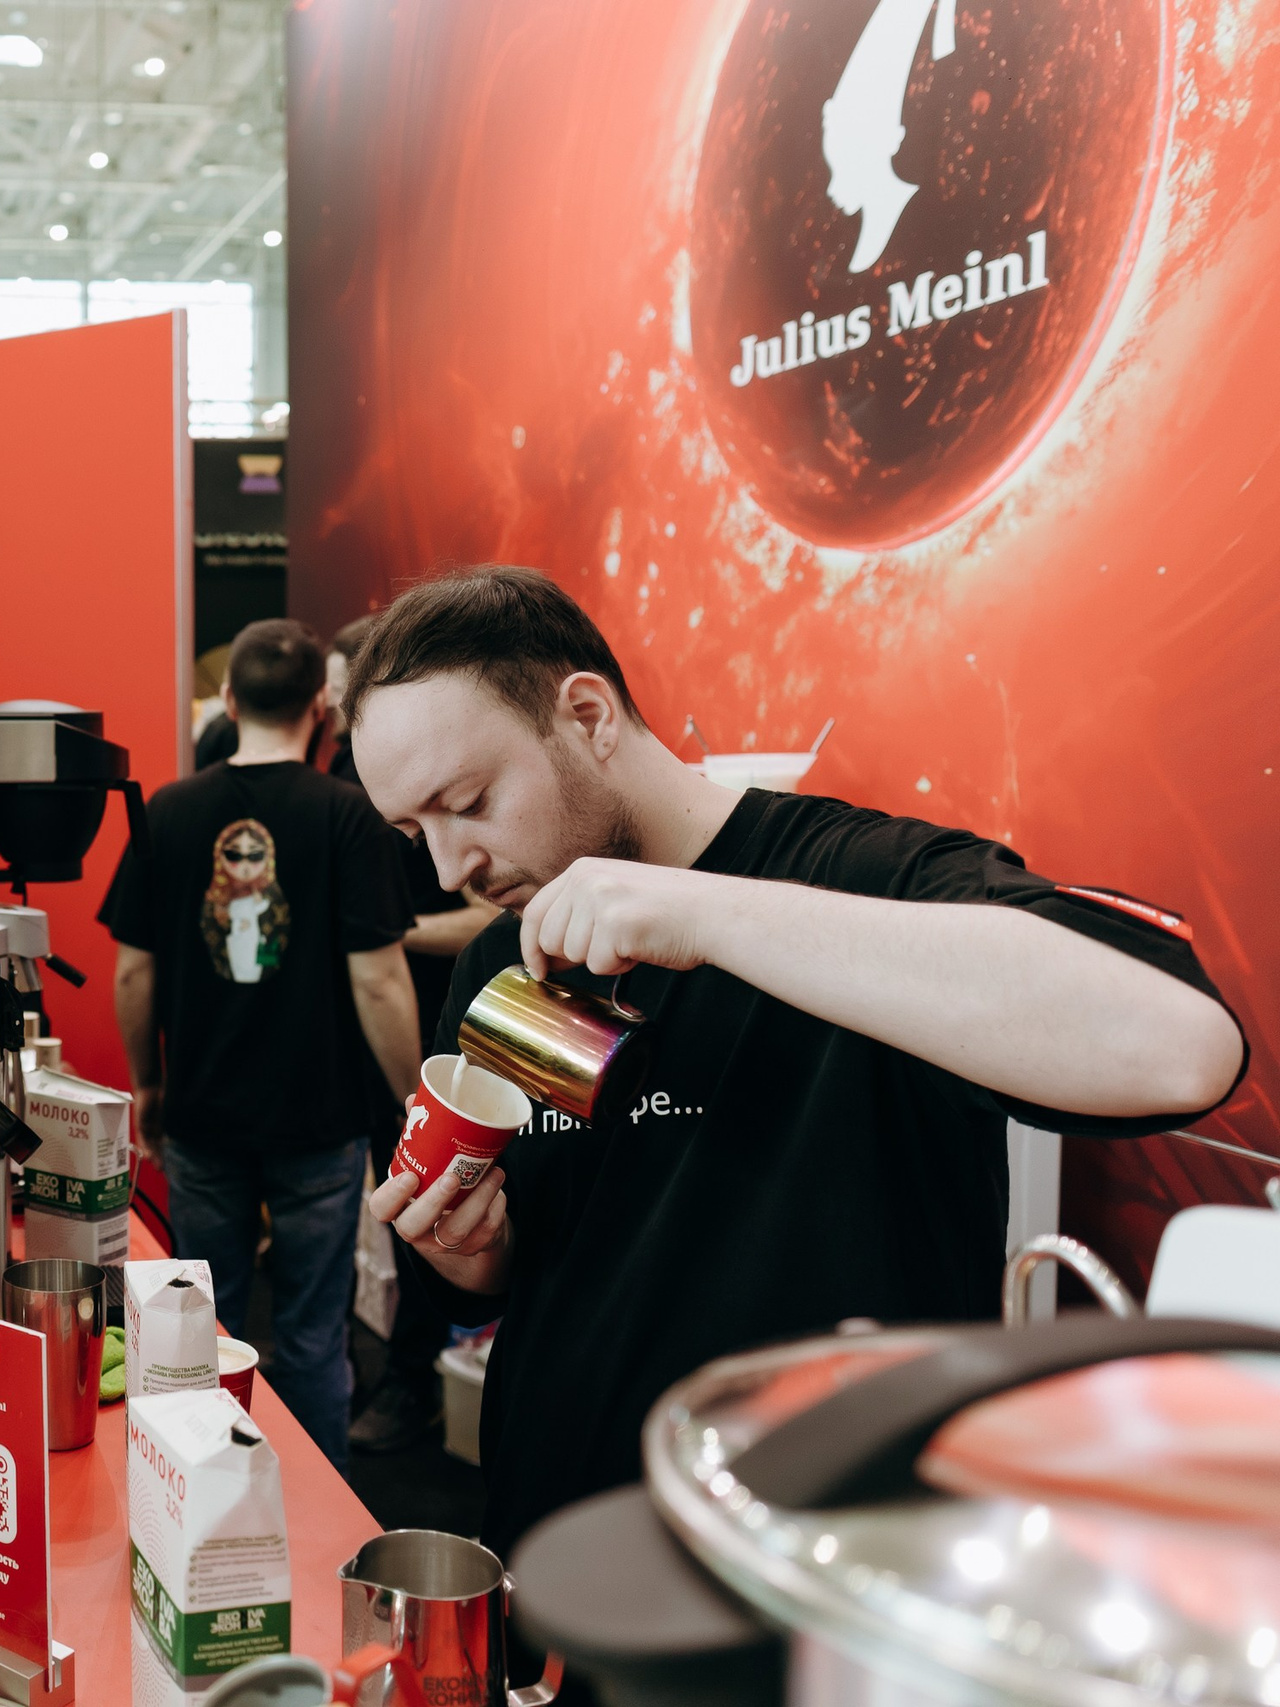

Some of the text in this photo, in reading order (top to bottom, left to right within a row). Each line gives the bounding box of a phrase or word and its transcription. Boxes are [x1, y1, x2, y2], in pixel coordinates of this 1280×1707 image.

[730, 229, 1050, 389] Julius Meinl
[29, 1101, 90, 1126] МОЛОКО
[402, 1147, 428, 1176] Meinl
[130, 1420, 186, 1501] МОЛОКО
[217, 1607, 266, 1623] EKO IVA
